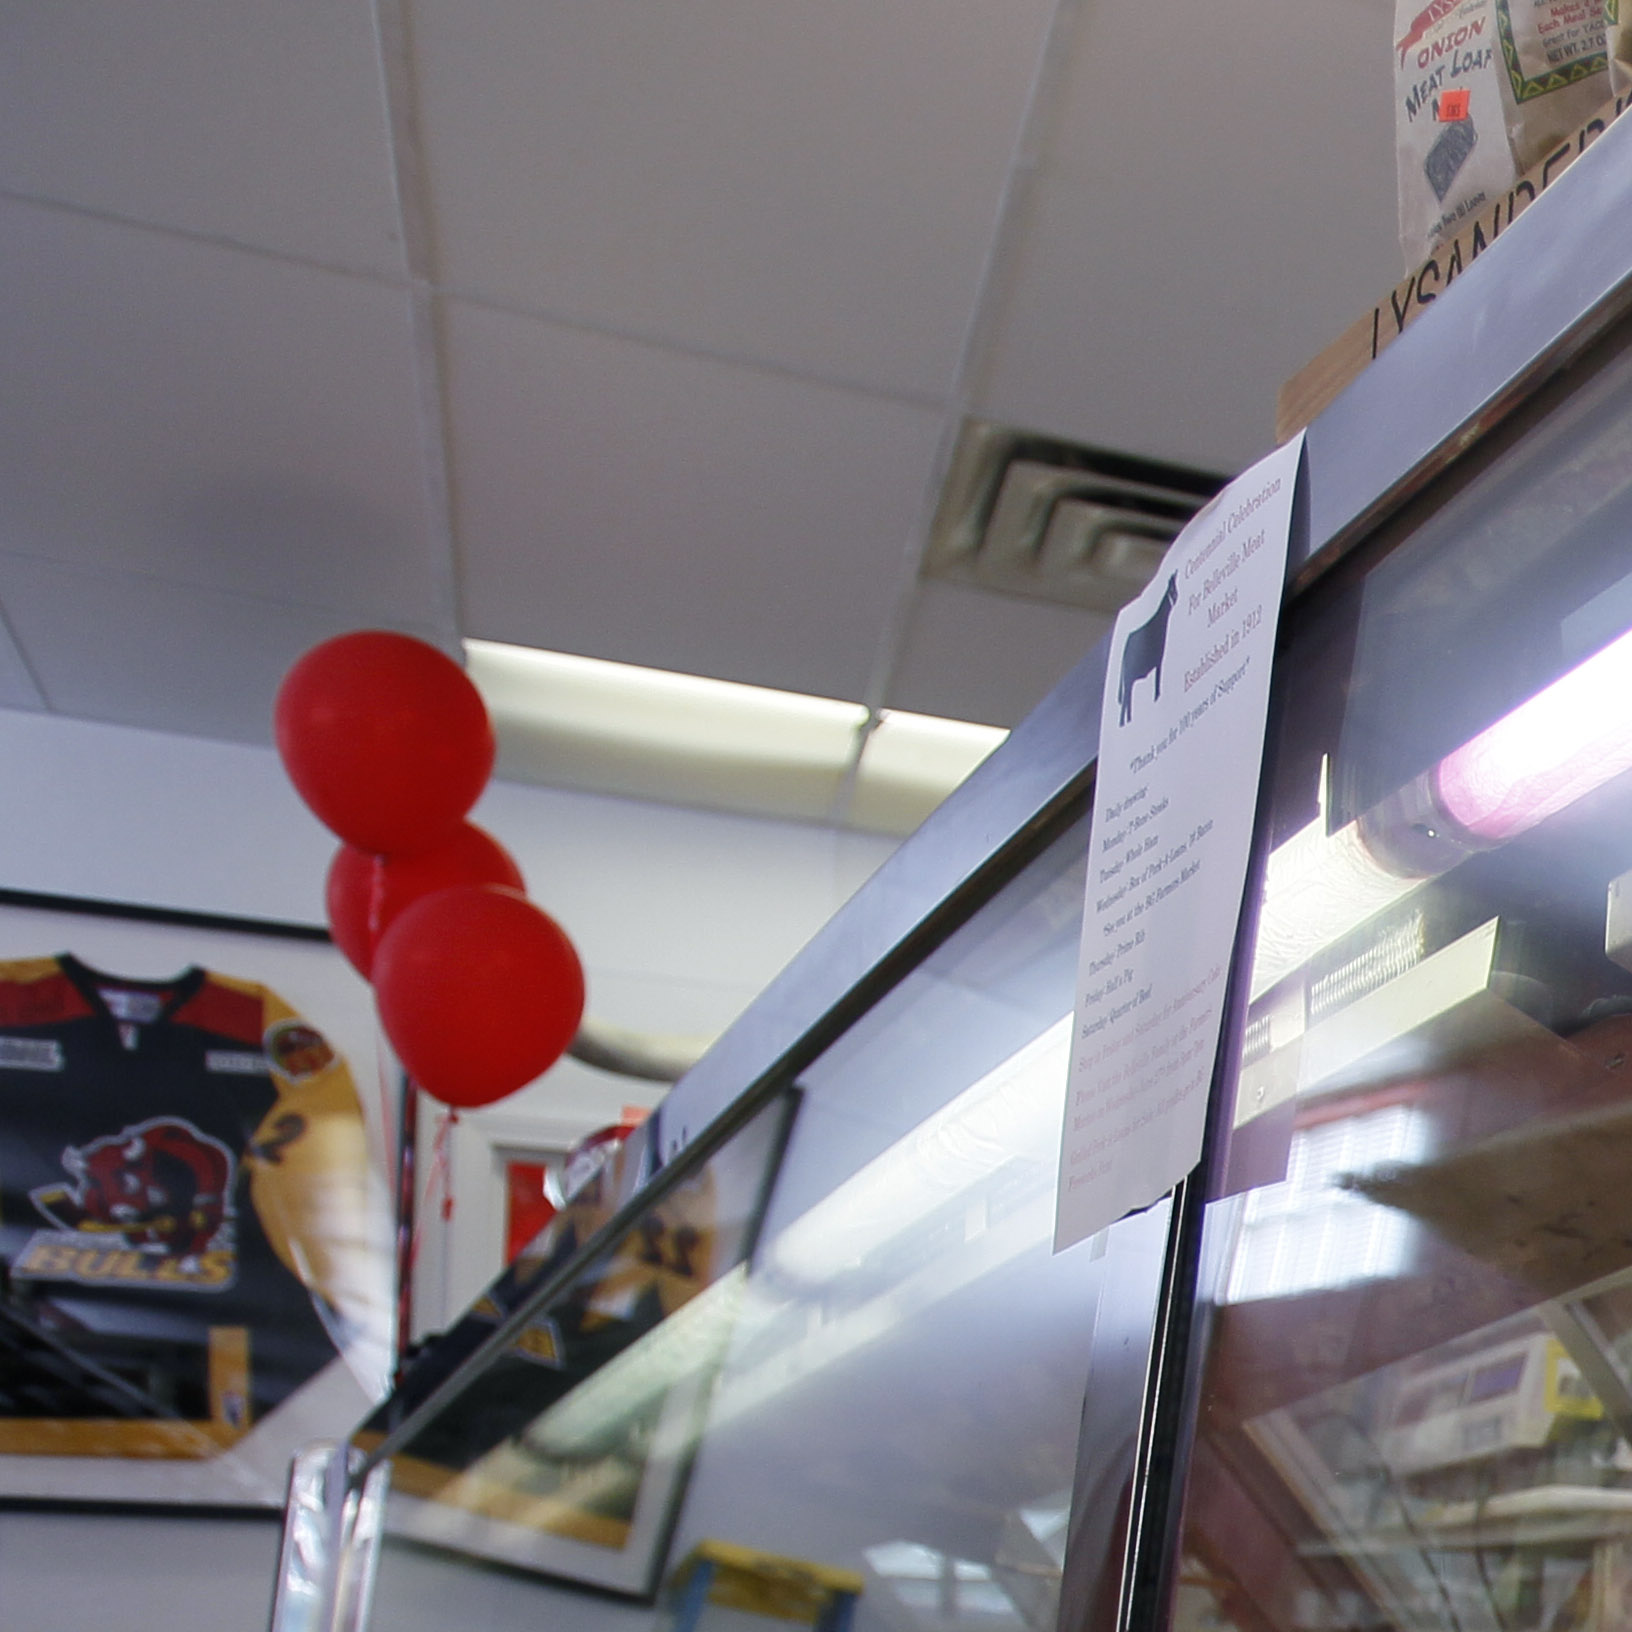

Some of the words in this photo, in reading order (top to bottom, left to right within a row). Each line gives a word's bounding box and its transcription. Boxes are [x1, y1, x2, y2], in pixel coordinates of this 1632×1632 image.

[1417, 16, 1487, 68] ONION
[1405, 65, 1446, 122] MEAT
[1450, 49, 1493, 78] LOAF
[1228, 478, 1281, 534] Celebration
[1203, 552, 1241, 600] Belleville
[1242, 529, 1265, 563] Meat
[1207, 588, 1239, 628] Market
[1184, 634, 1230, 693] Established
[1231, 629, 1240, 645] in
[21, 1245, 236, 1285] BULLS
